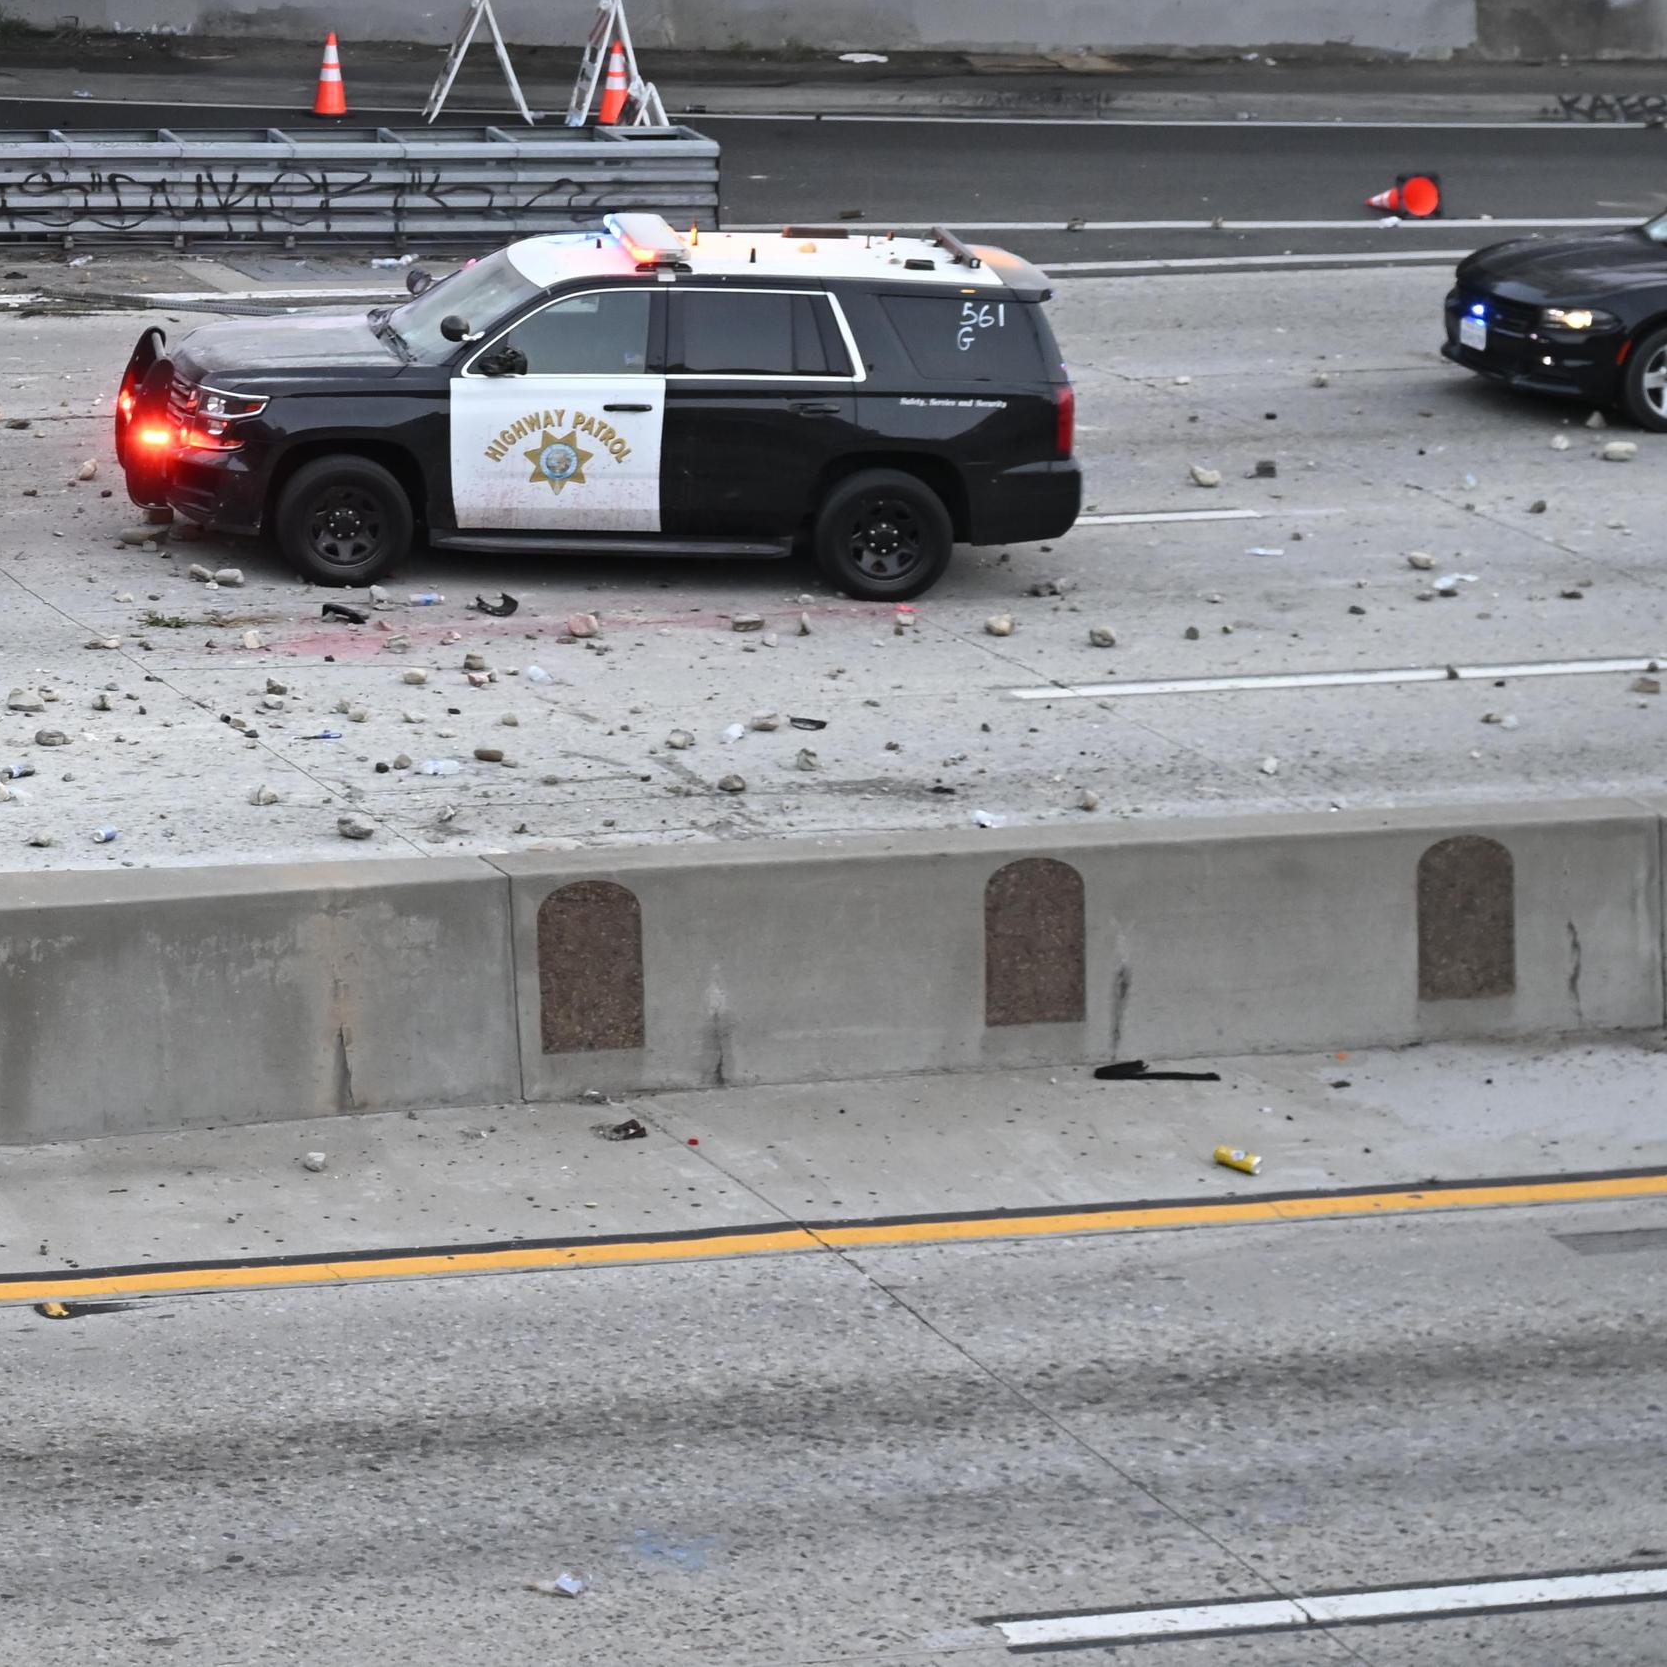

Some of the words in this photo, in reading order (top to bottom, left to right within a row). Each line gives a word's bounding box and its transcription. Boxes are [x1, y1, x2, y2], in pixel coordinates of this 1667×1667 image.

[959, 301, 1005, 328] 561
[957, 326, 975, 351] G
[484, 409, 566, 463] HIGHWAY
[572, 411, 632, 464] PATROL
